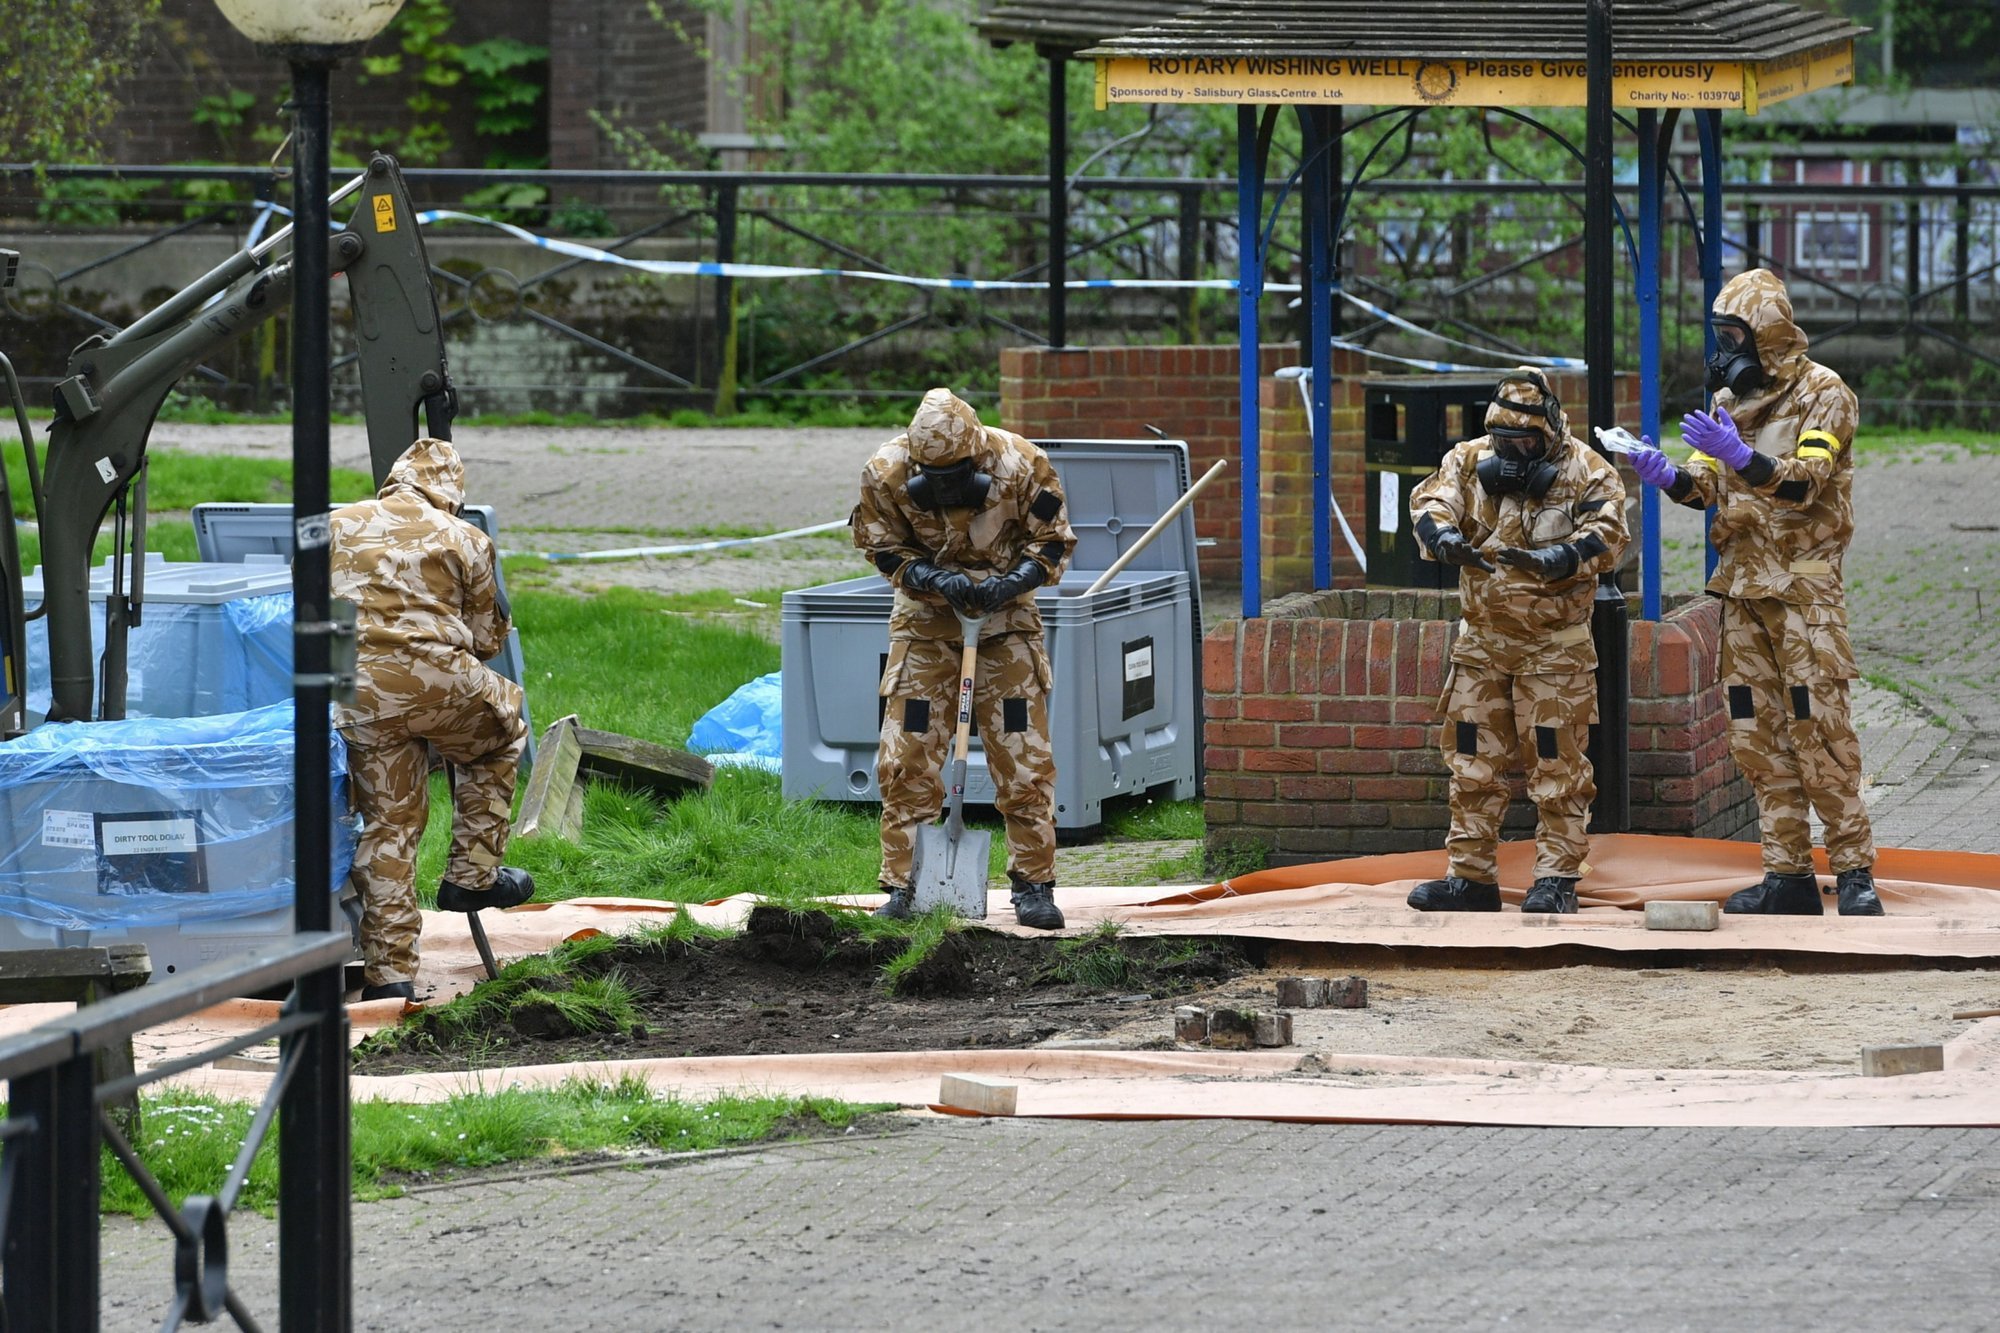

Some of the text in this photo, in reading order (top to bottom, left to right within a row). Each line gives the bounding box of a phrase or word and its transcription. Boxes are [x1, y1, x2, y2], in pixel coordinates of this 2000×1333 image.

[1149, 57, 1409, 76] ROTARY WISHING WELL
[1465, 60, 1715, 82] Please Give enerously
[1110, 87, 1168, 98] Sponsored
[1171, 87, 1184, 98] by
[1194, 88, 1243, 99] Salisbury
[1247, 88, 1277, 98] Glass
[1281, 88, 1317, 98] Centre
[1630, 91, 1668, 102] Charity
[1698, 91, 1741, 100] 1039708
[114, 835, 136, 843] DIRTY
[138, 834, 159, 842] TOOL
